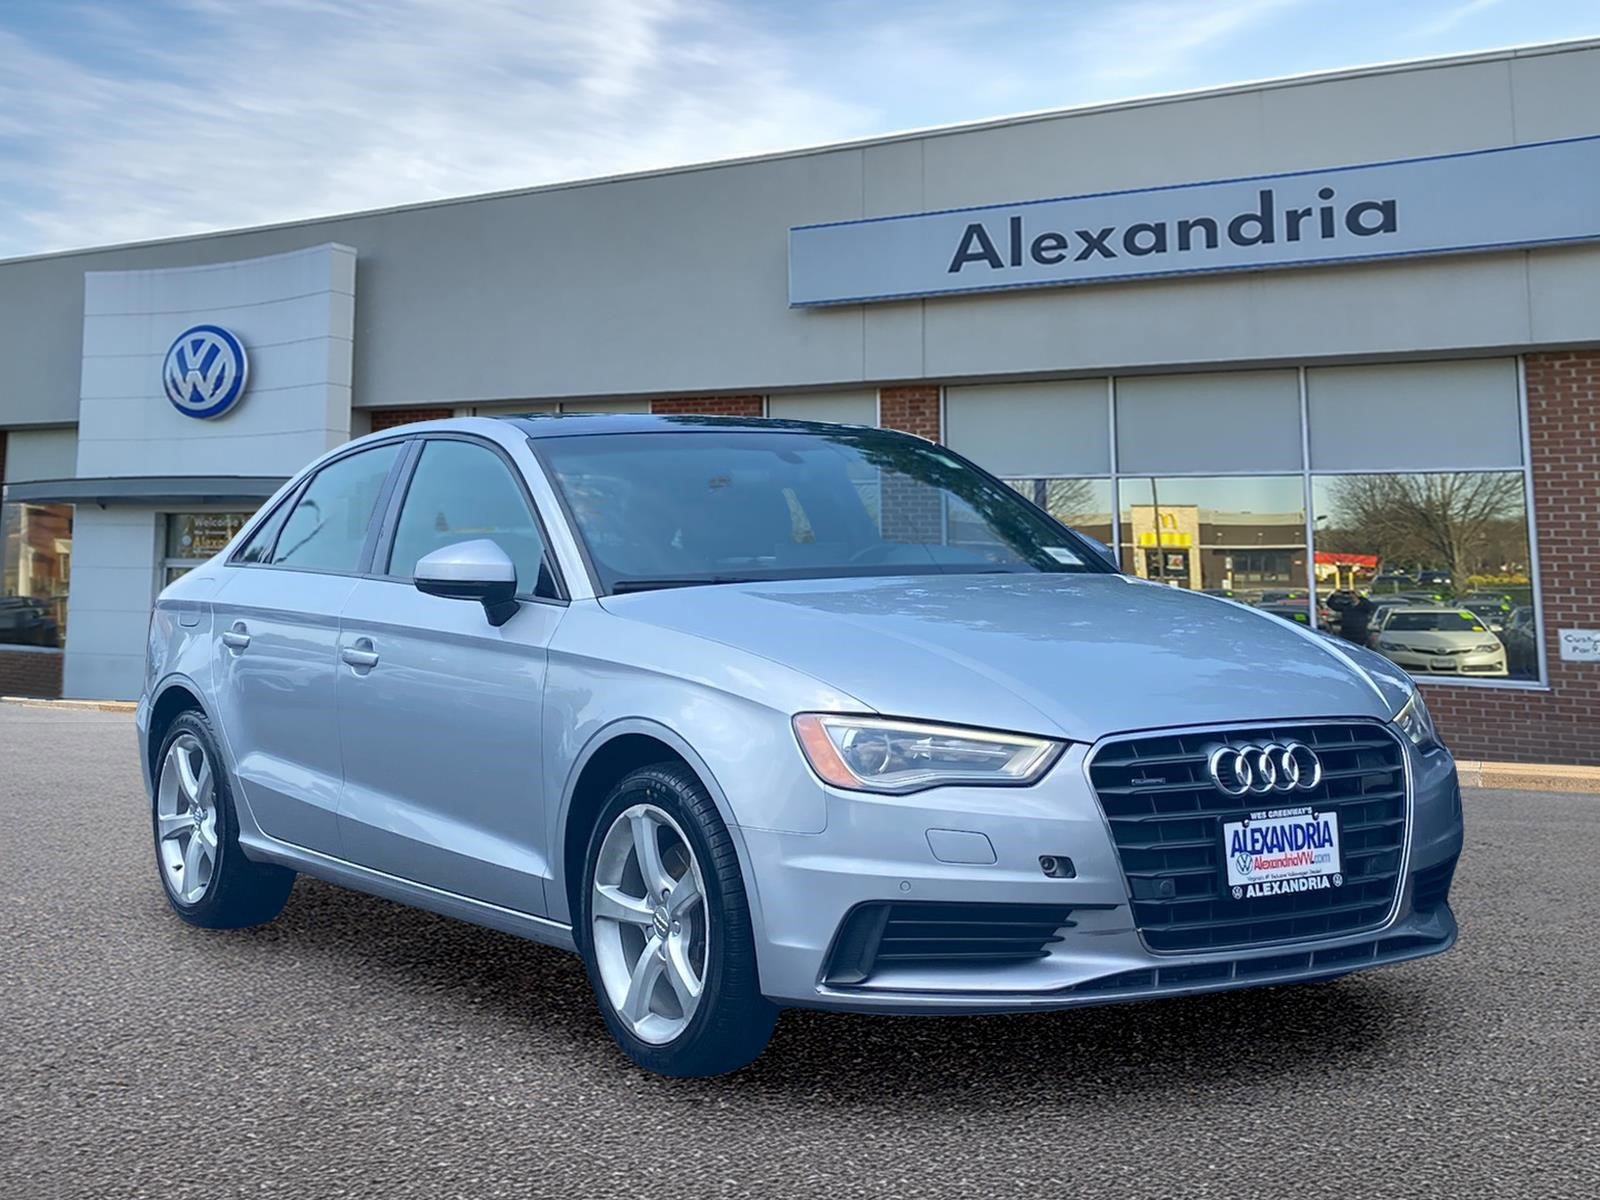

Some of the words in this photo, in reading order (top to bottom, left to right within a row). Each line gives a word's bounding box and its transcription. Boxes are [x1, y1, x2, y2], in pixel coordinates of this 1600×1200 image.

[948, 187, 1398, 274] Alexandria
[165, 331, 237, 411] VW
[1230, 820, 1334, 858] ALEXANDRIA
[1253, 850, 1331, 871] AlexandriaVW.com
[1246, 875, 1331, 898] ALEXANDRIA
